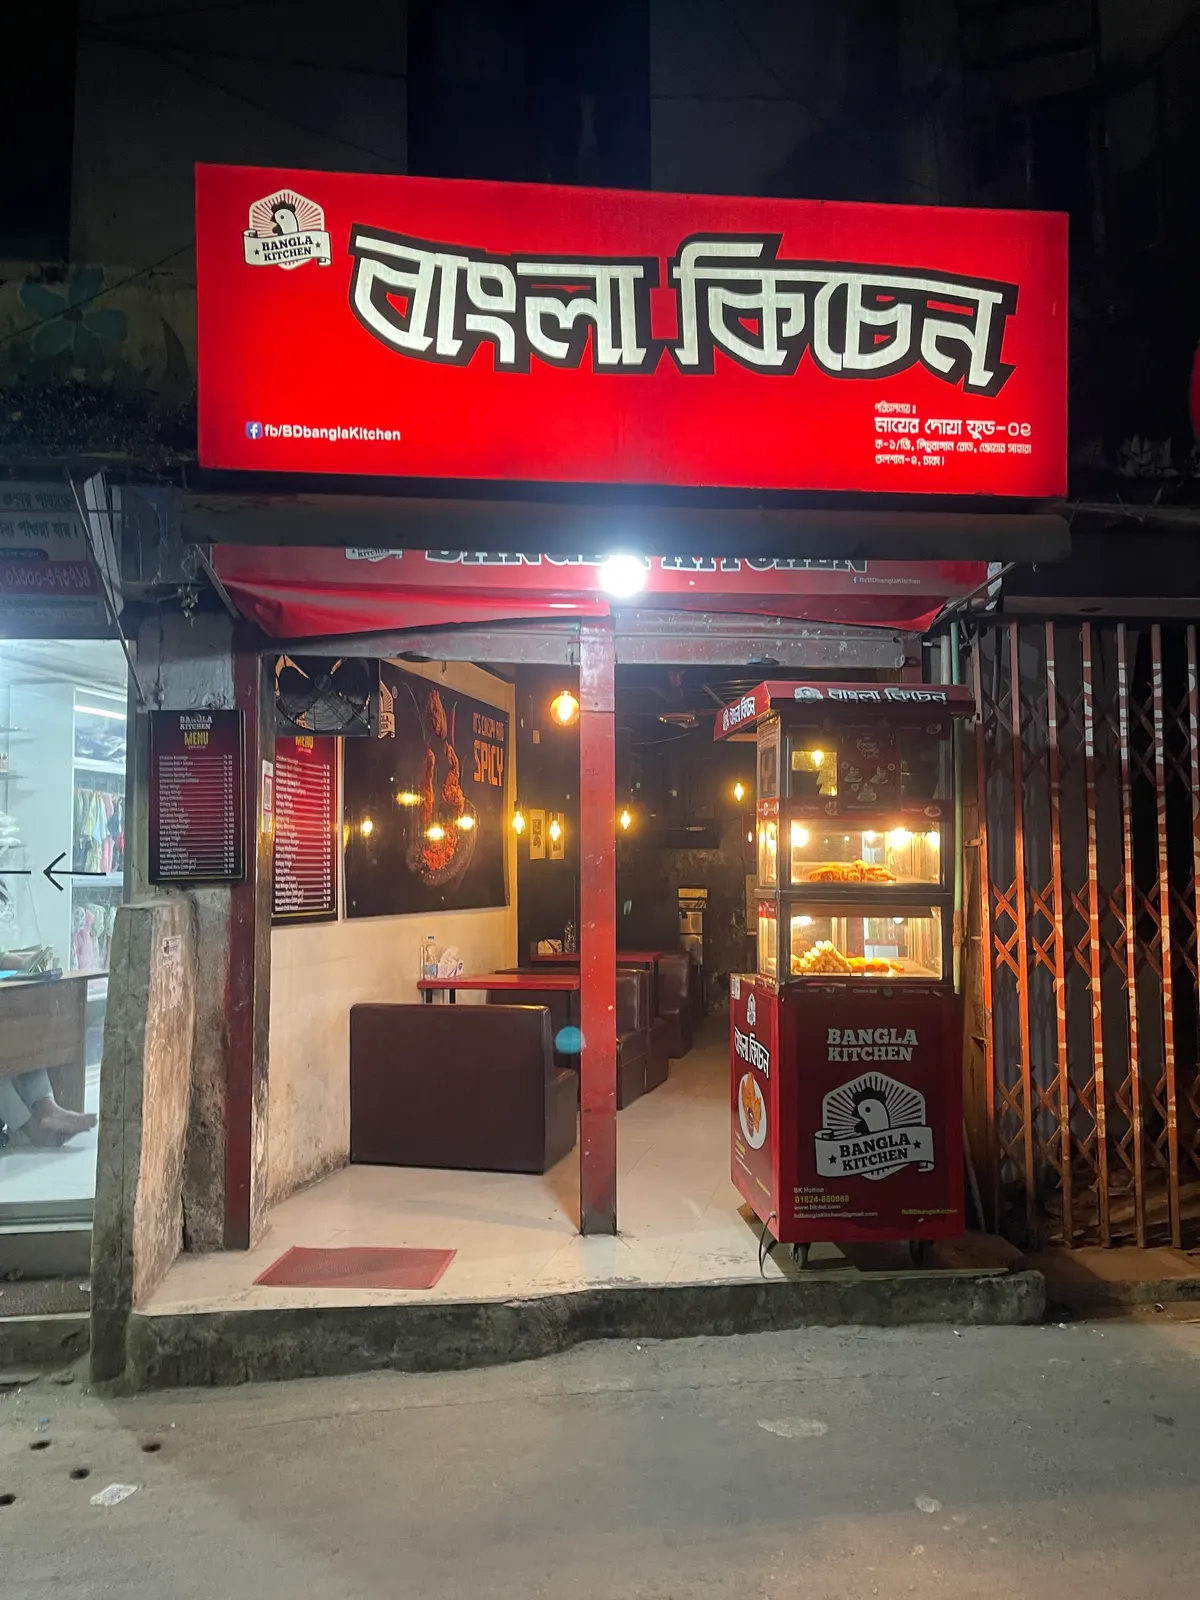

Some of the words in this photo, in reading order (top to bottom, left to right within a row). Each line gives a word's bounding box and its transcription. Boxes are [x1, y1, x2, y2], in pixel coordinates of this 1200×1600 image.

[261, 235, 314, 252] BANGLA
[263, 246, 312, 261] KITCHEN
[355, 234, 645, 366] বাংলা
[672, 242, 1003, 388] কিচেন
[264, 424, 401, 442] fb/BDbanglaKitchen
[874, 416, 920, 434] মায়ের
[924, 419, 963, 435] দোয়া
[184, 730, 209, 746] MENU
[473, 739, 505, 787] SPICY
[826, 1028, 919, 1046] BANGLA
[827, 1045, 913, 1062] KITCHEN
[838, 1132, 912, 1159] BANGLA
[842, 1149, 909, 1172] KITCHEN
